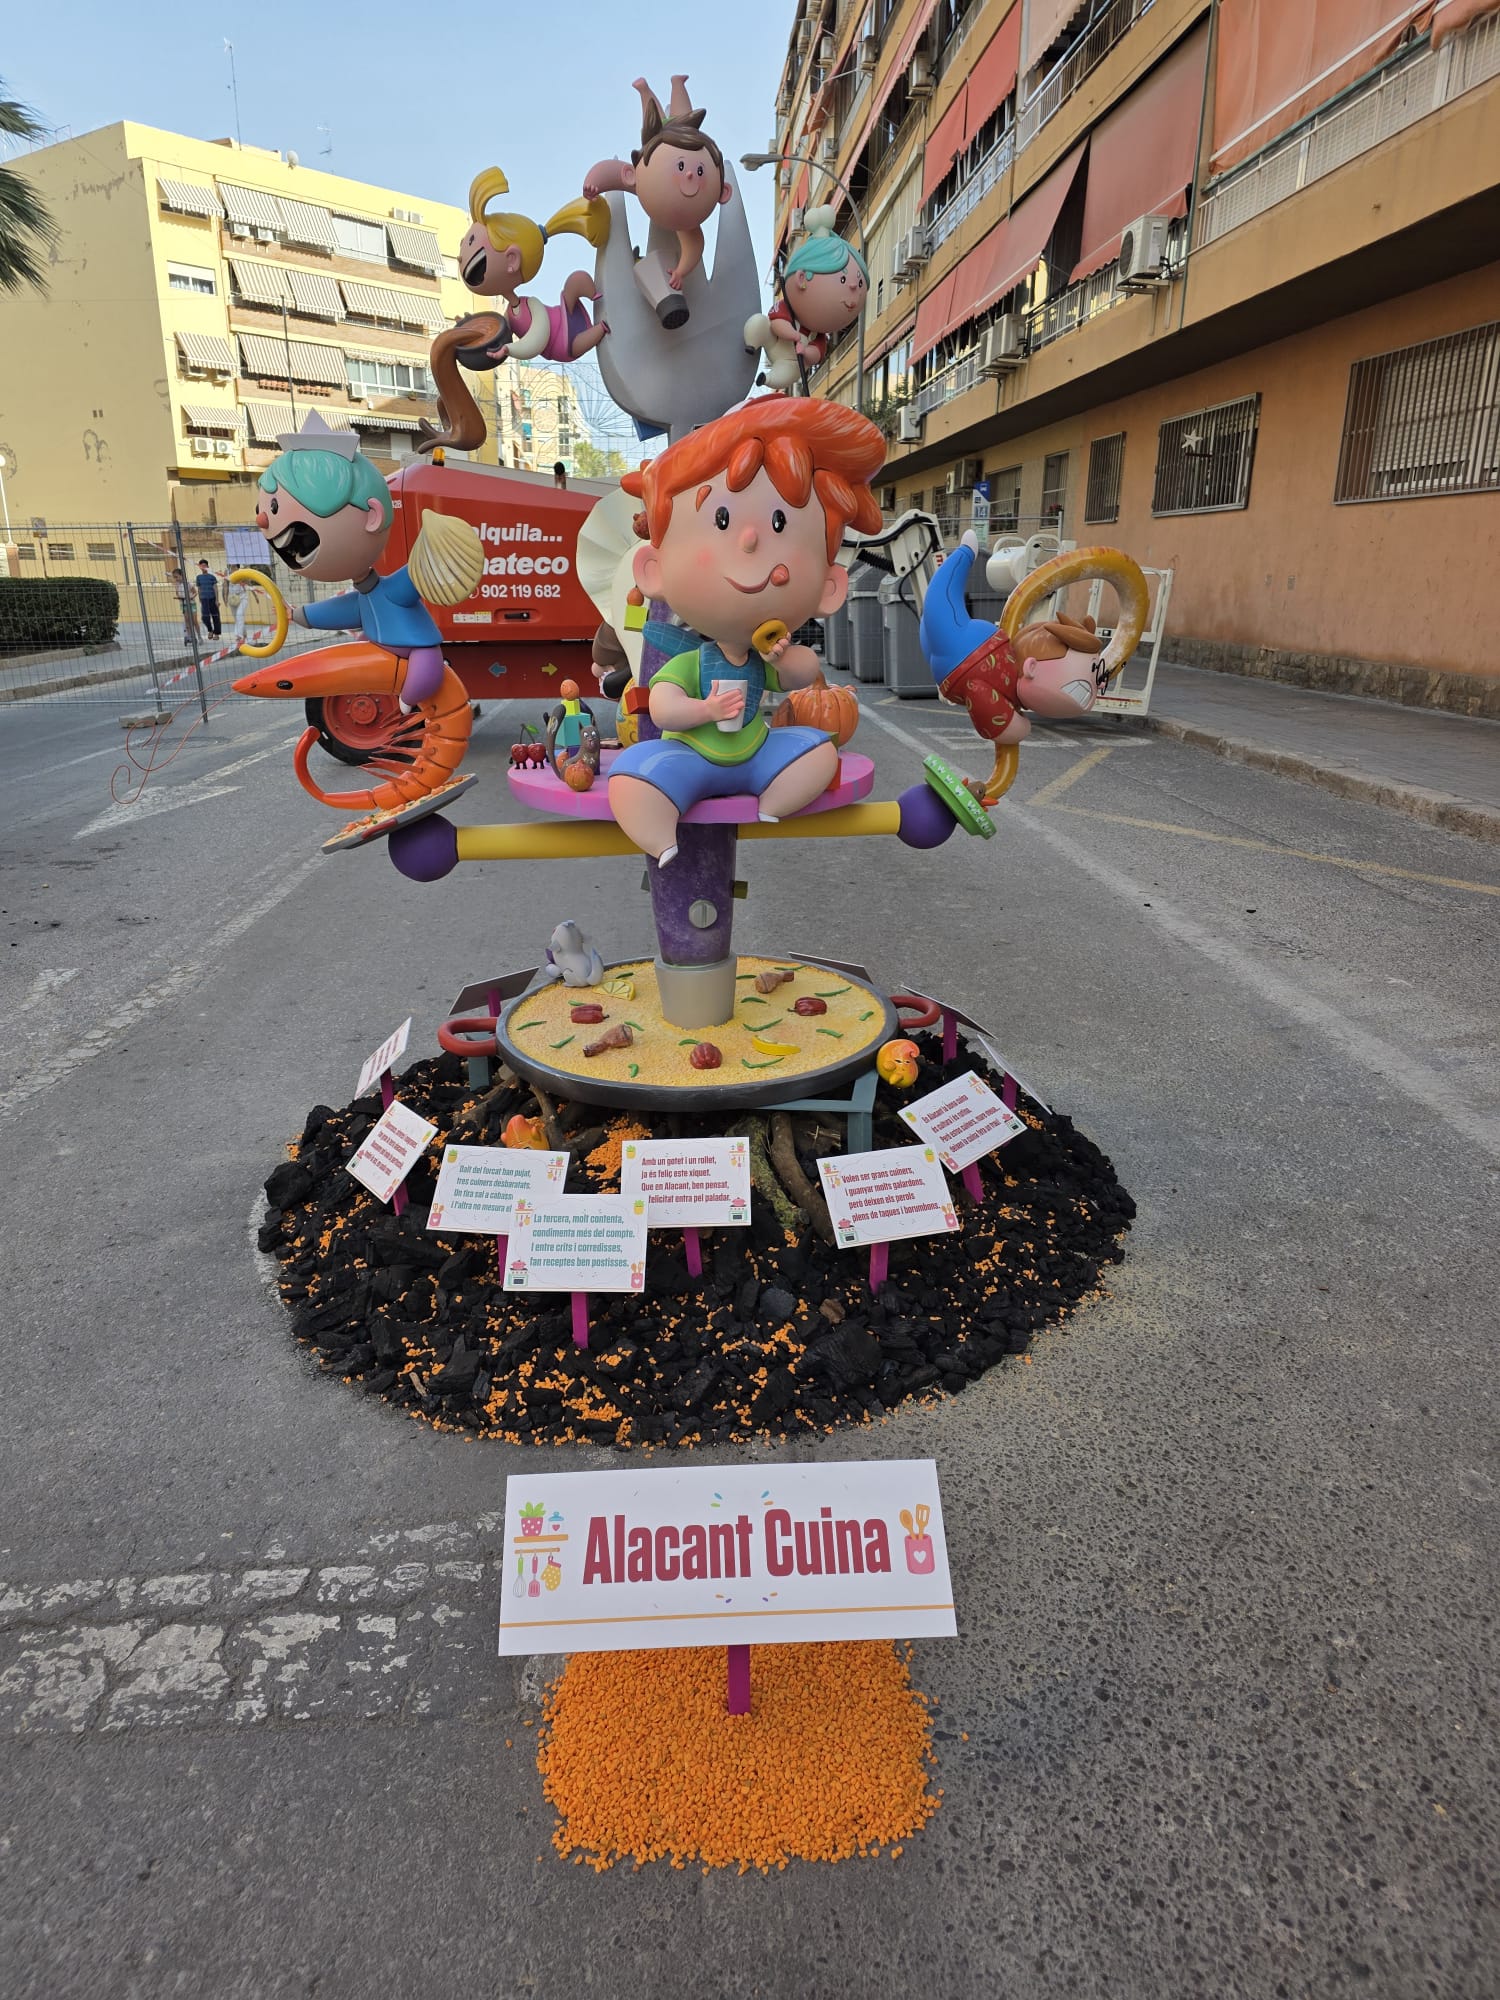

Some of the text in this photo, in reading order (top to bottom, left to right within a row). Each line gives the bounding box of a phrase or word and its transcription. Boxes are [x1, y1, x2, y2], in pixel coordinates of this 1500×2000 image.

[481, 584, 560, 598] 902 119 682
[667, 1157, 684, 1166] gotet
[698, 1156, 716, 1165] rollet,
[641, 1171, 647, 1179] ja
[658, 1170, 672, 1178] feliç
[842, 1174, 859, 1183] Volen
[871, 1171, 888, 1181] grans
[890, 1168, 914, 1178] cuiners,
[457, 1177, 468, 1185] tres
[642, 1183, 653, 1191] Que
[665, 1182, 691, 1190] Alacant,
[692, 1181, 704, 1189] ben
[706, 1181, 729, 1190] pensat,
[849, 1185, 873, 1196] guanyar
[649, 1195, 673, 1203] felicitat
[694, 1194, 703, 1202] pel
[705, 1194, 731, 1202] paladar.
[865, 1196, 885, 1206] deixen
[886, 1195, 895, 1203] els
[534, 1214, 624, 1224] La tercera, molt contenta,
[852, 1212, 869, 1222] plens
[871, 1211, 878, 1219] de
[879, 1208, 900, 1219] taques
[533, 1228, 635, 1239] condimenta més del compte.
[556, 1243, 572, 1251] crits
[578, 1244, 622, 1253] corredisses,
[530, 1258, 629, 1268] fan receptes ben postisses.
[582, 1507, 892, 1585] Alacant Cuina
